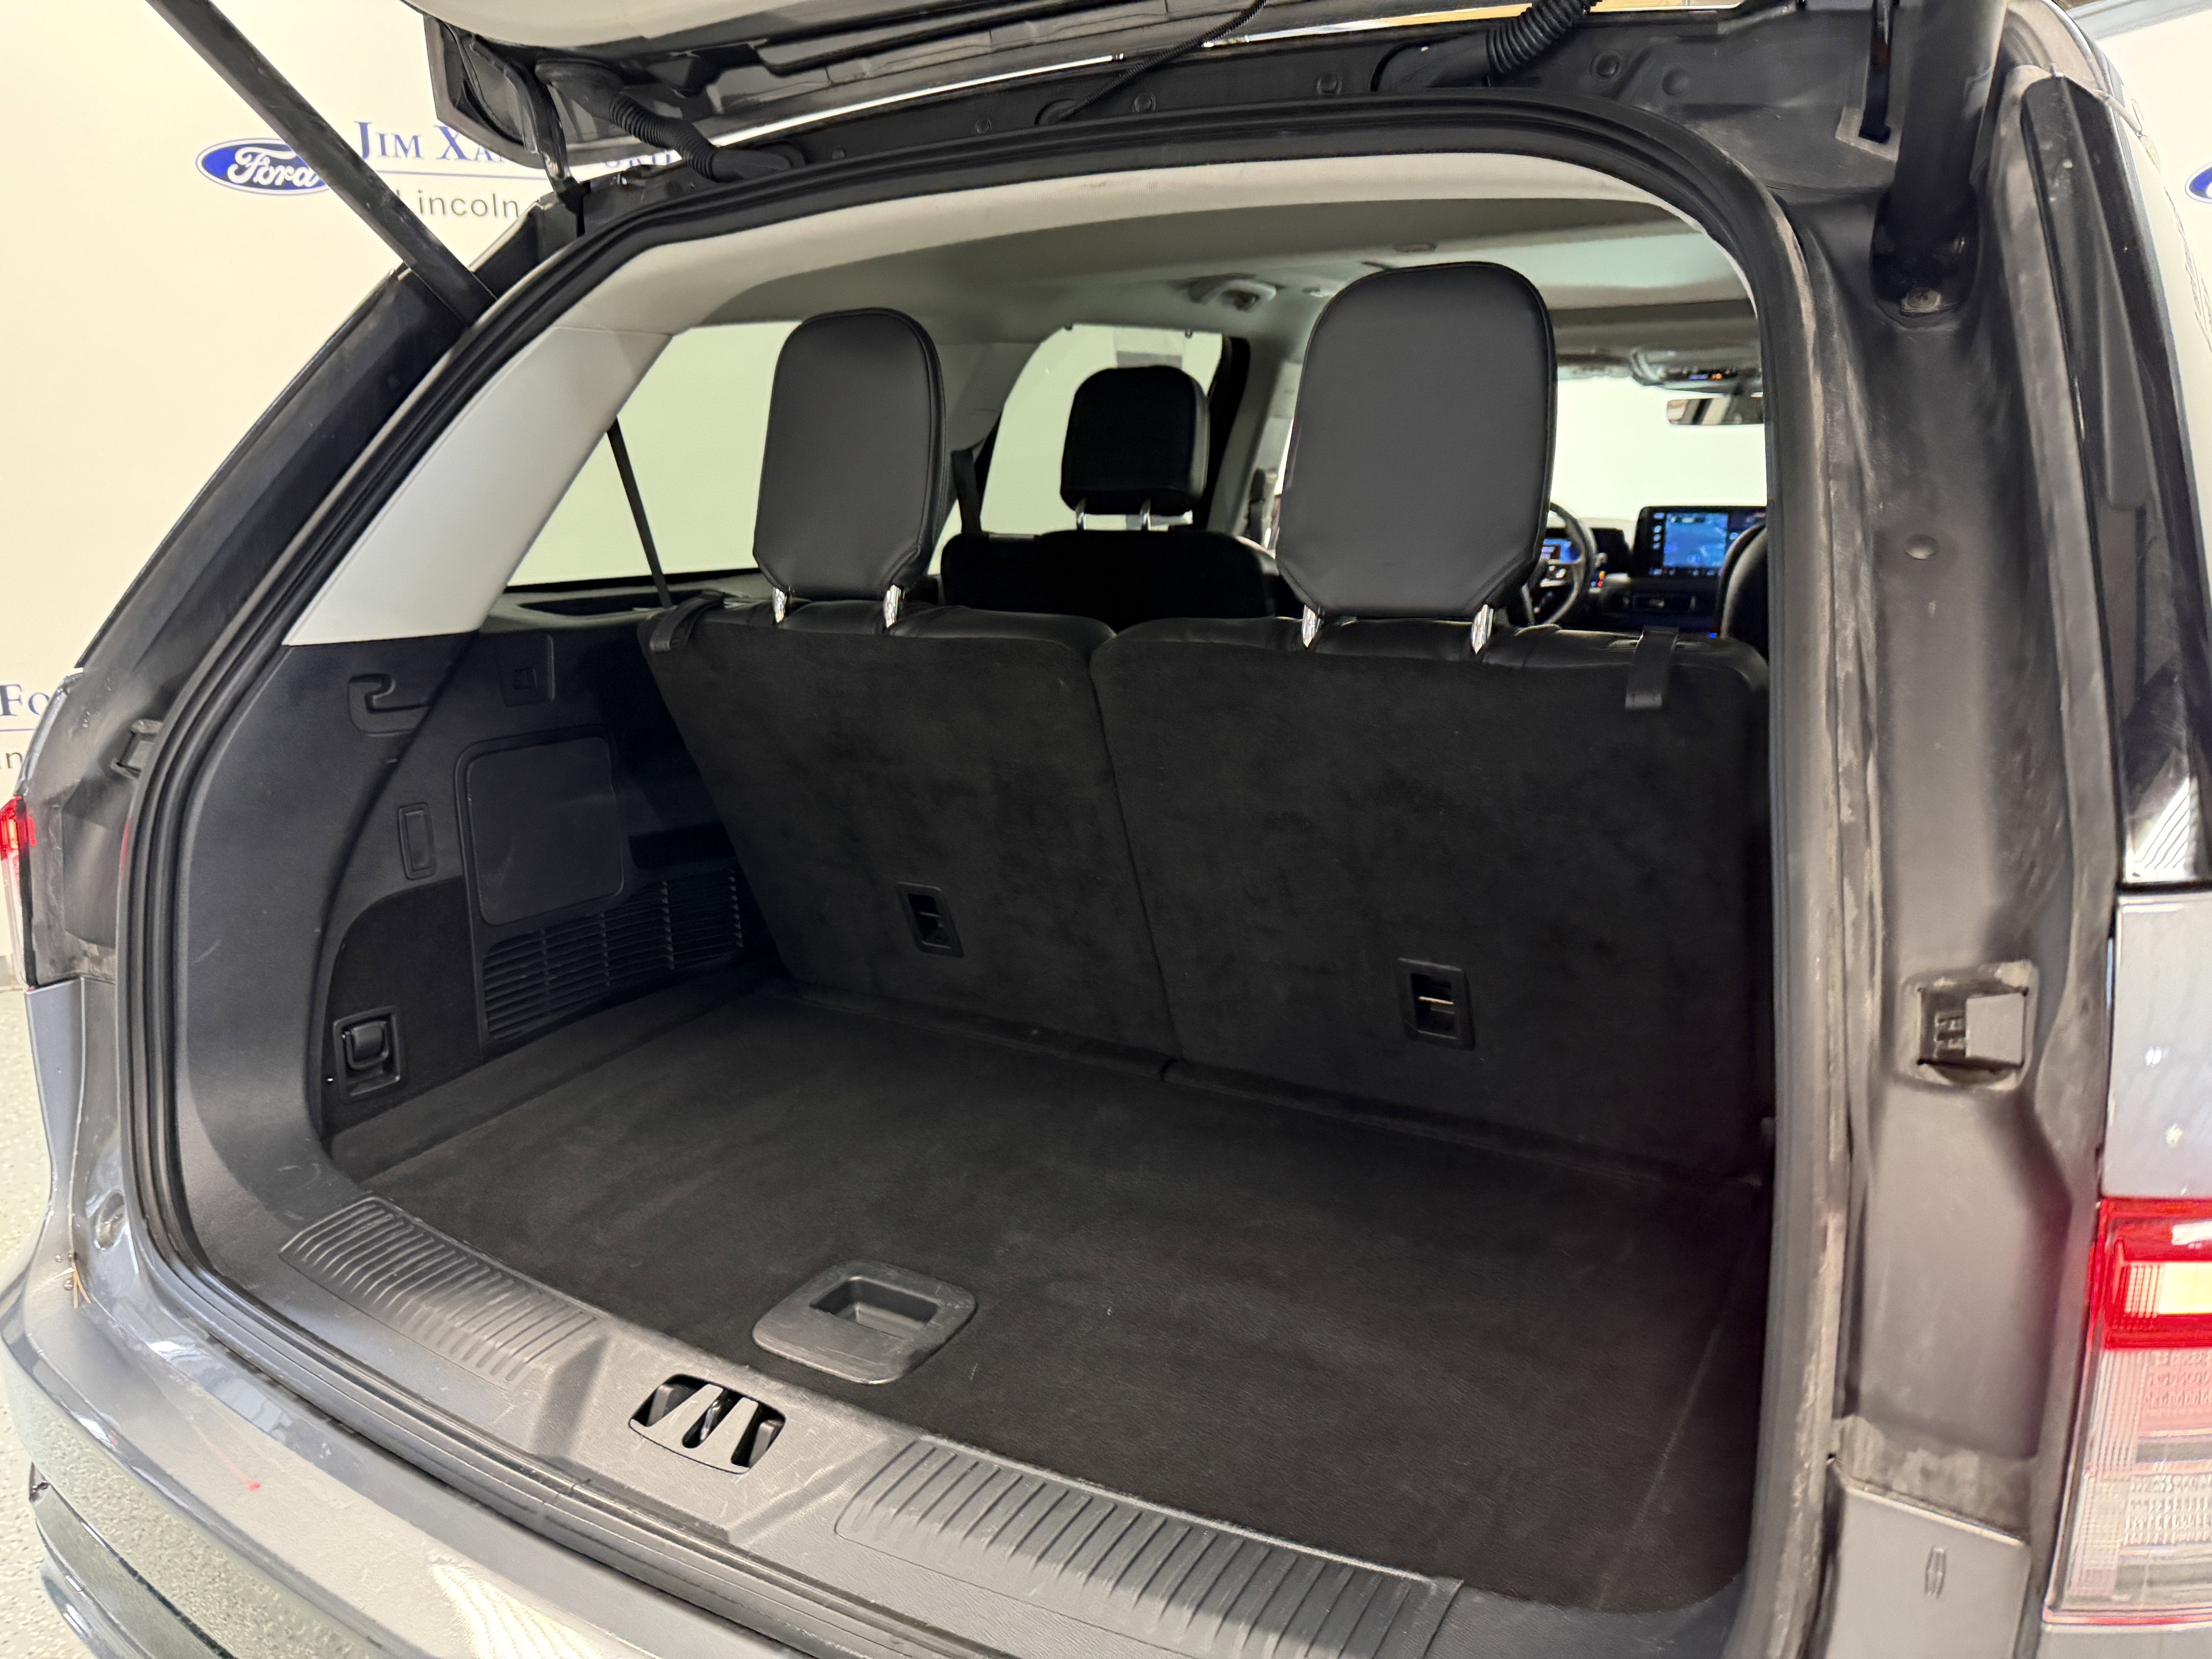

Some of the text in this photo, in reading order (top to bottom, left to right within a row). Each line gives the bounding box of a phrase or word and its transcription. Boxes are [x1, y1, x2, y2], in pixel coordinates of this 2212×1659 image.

[354, 120, 505, 163] JIM XA
[227, 147, 321, 187] Ford
[396, 190, 519, 218] incoln
